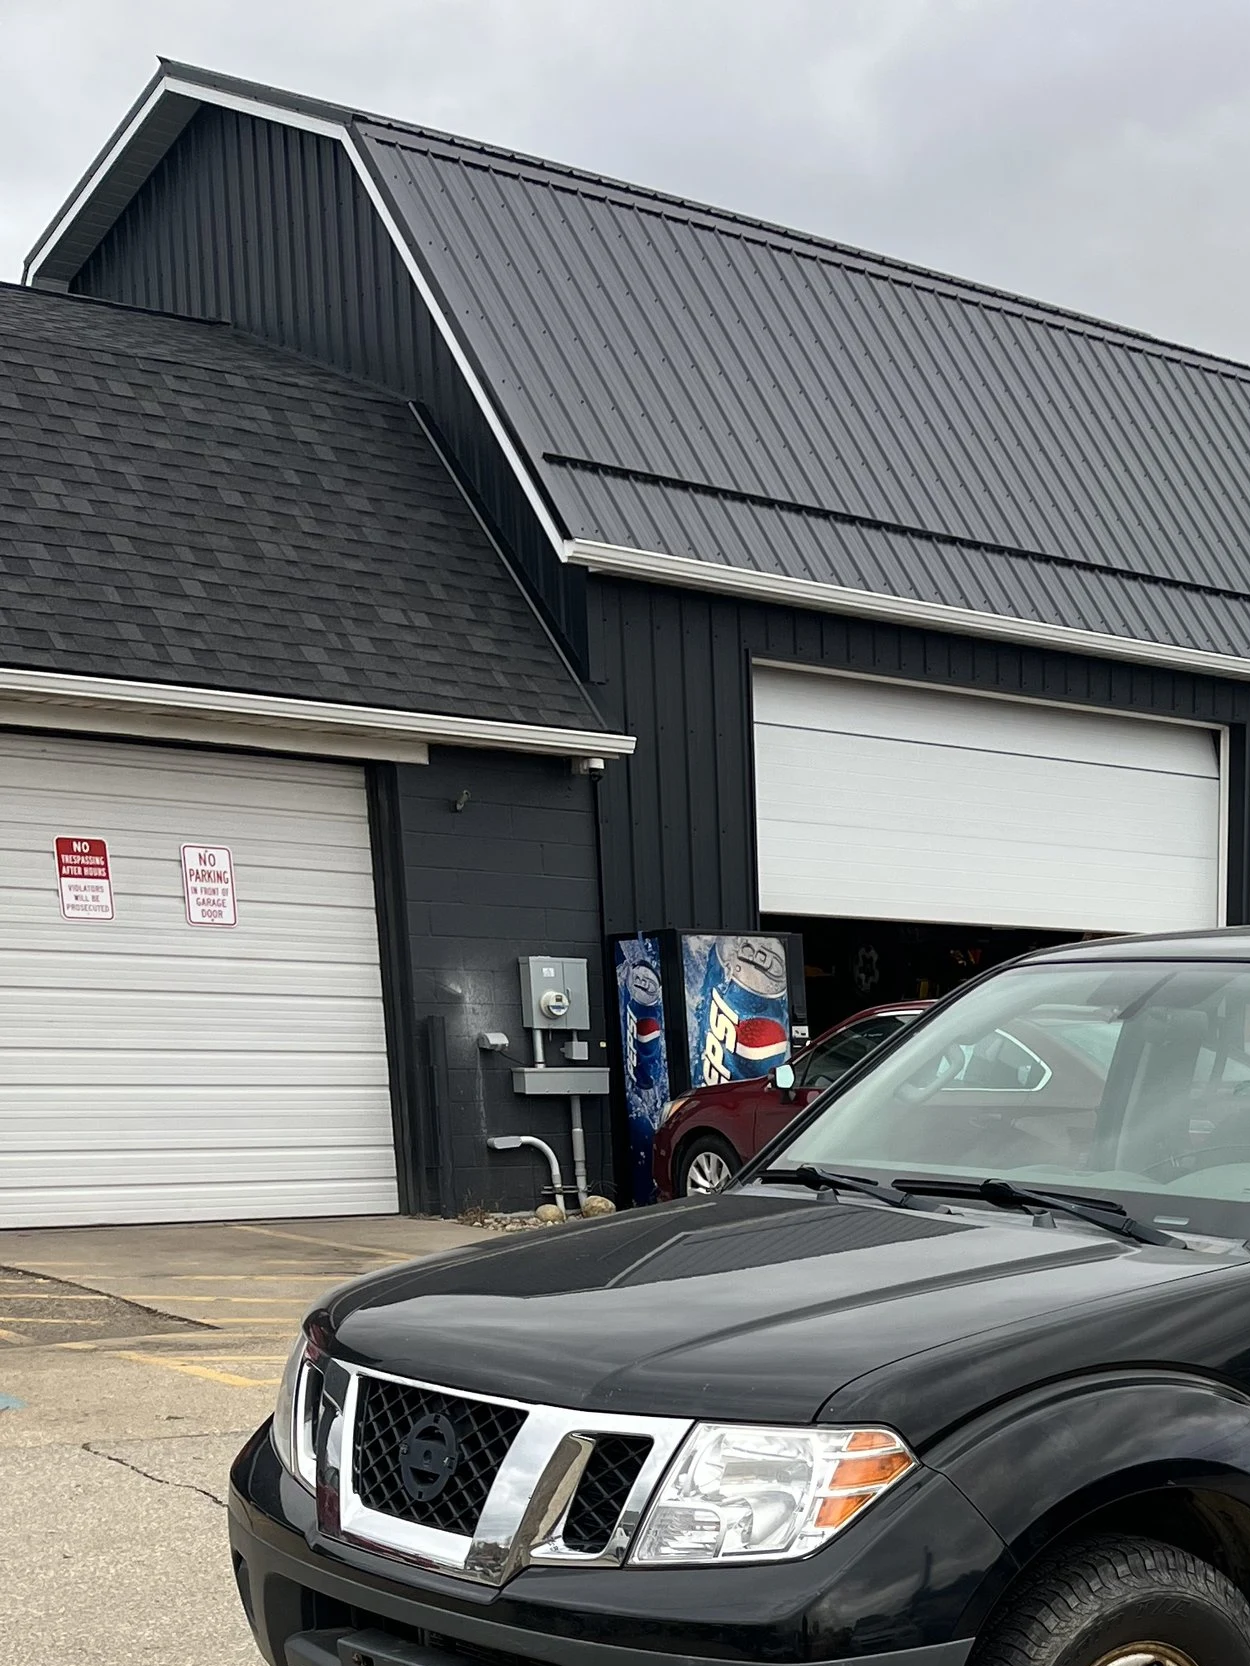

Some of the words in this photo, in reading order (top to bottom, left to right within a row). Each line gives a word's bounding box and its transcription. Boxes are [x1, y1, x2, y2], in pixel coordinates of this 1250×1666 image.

[72, 841, 90, 853] NO
[61, 854, 105, 866] TRESPASSING
[198, 852, 216, 867] NO
[61, 866, 83, 876] AFTER
[83, 867, 107, 877] HOURS
[188, 868, 229, 884] PARKING
[68, 884, 105, 893] VIOLATORS
[190, 886, 198, 895] IN
[200, 886, 219, 896] FRONT
[74, 894, 90, 902] WILL
[91, 894, 100, 903] BE
[196, 897, 227, 908] GARAGE
[66, 903, 110, 913] PROSECUTED
[201, 909, 224, 919] DOOR
[702, 987, 739, 1086] EPSI
[626, 1004, 638, 1082] PEPSI
